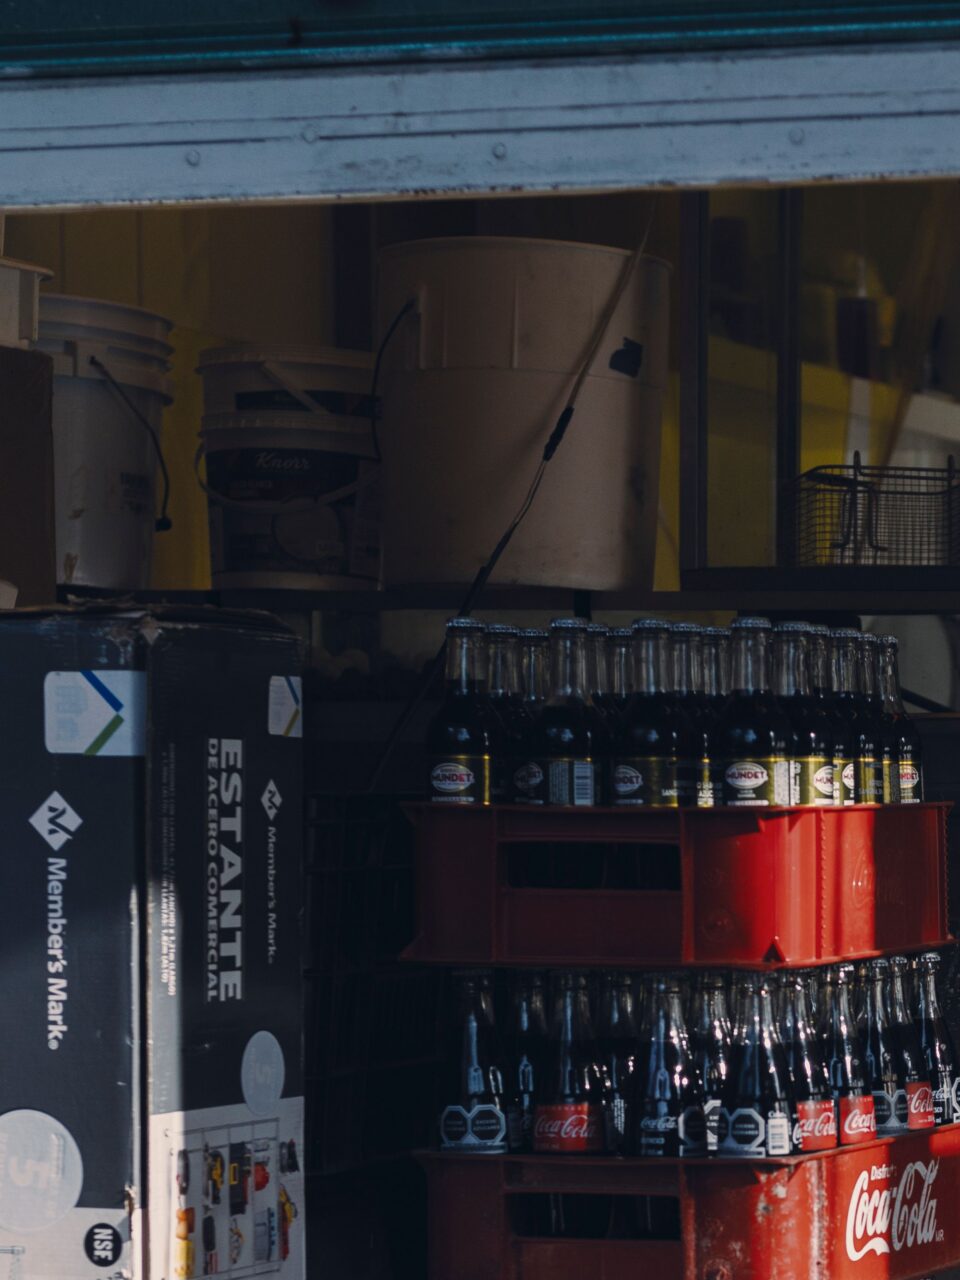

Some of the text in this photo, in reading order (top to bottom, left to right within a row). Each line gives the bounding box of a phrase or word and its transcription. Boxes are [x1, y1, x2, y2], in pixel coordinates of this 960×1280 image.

[255, 452, 311, 471] Knorr
[207, 738, 218, 1002] DE ACERO COMERCIAL
[219, 738, 243, 1002] ESTANTE
[266, 826, 277, 910] Member's
[46, 857, 68, 1042] Member's Mark
[93, 1228, 114, 1260] NSF
[846, 1158, 940, 1261] Coca-Cola
